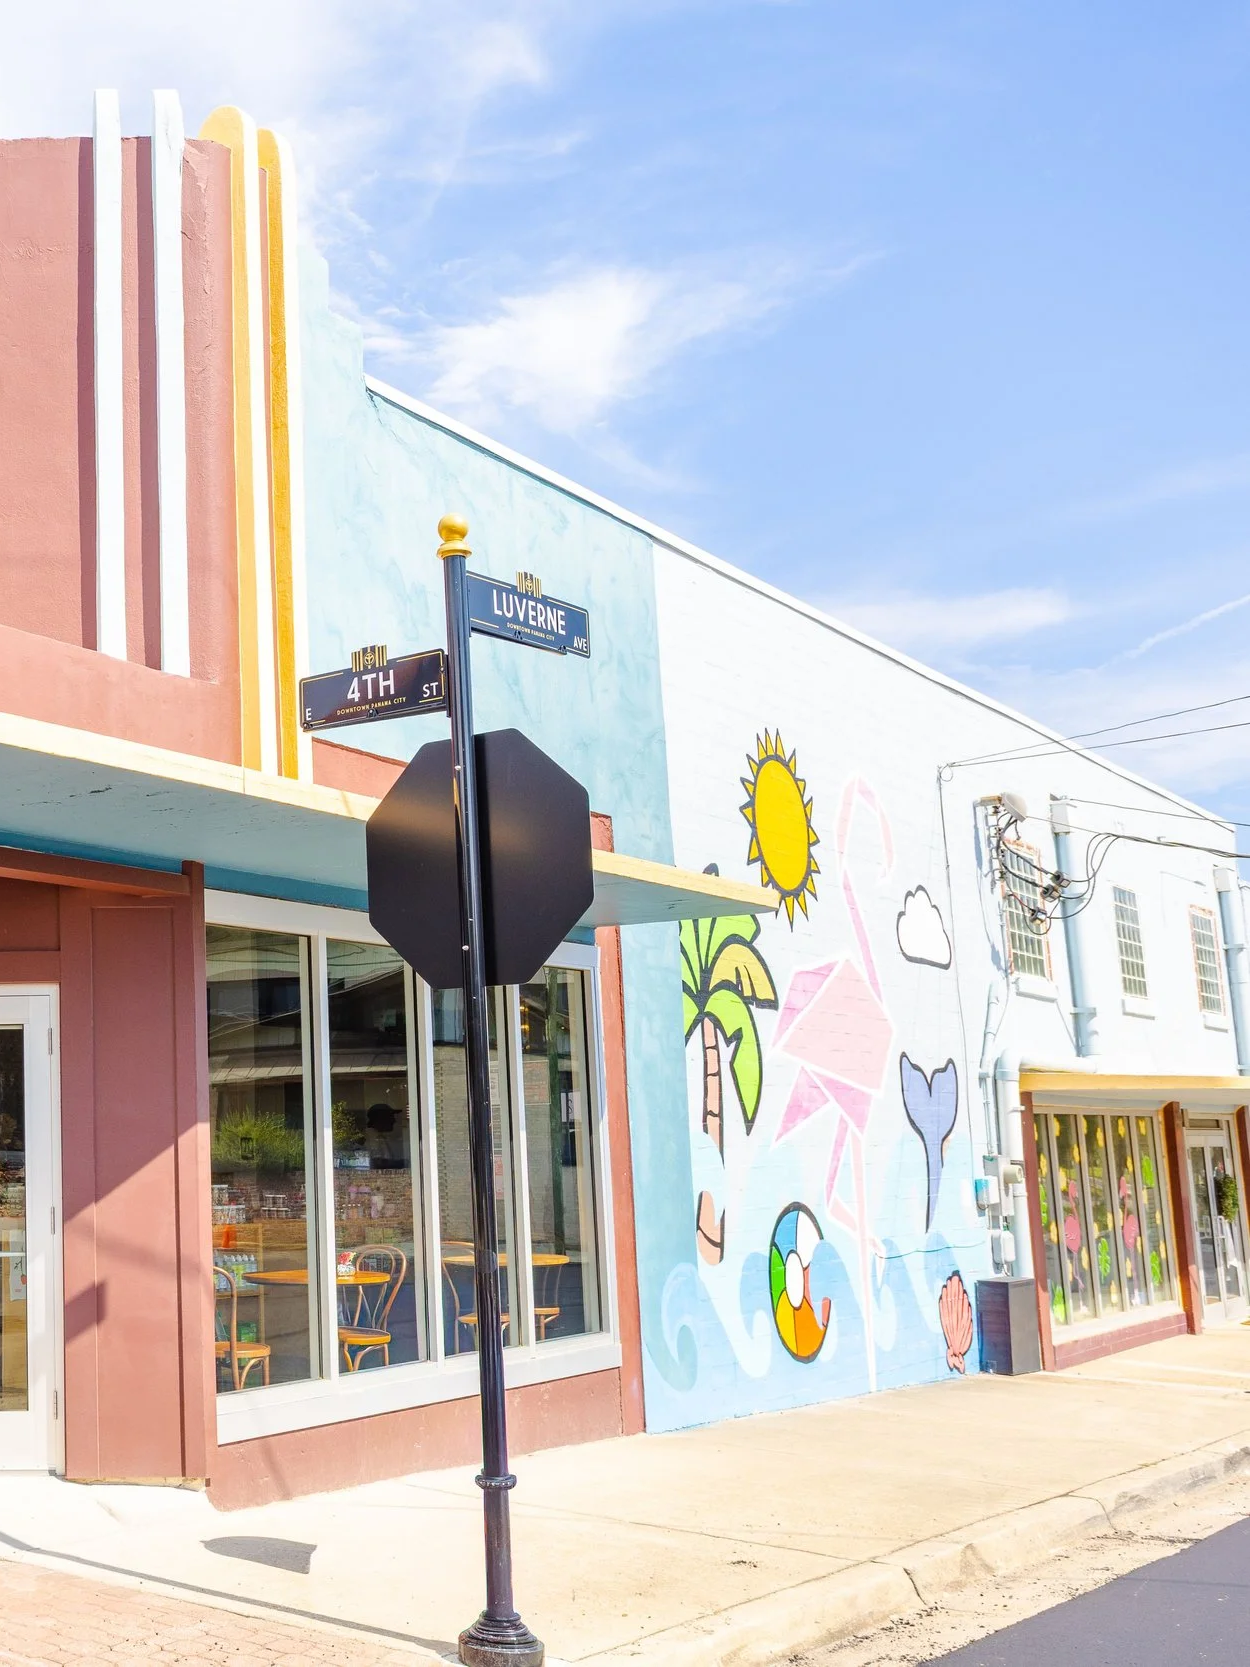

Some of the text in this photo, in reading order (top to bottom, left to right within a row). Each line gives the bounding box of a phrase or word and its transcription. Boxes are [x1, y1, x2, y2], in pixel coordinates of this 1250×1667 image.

[493, 589, 587, 651] LUVERNE AVE
[305, 669, 439, 720] E 4TH ST
[337, 705, 370, 716] DOWNTOWN
[371, 701, 392, 709] PANAMA
